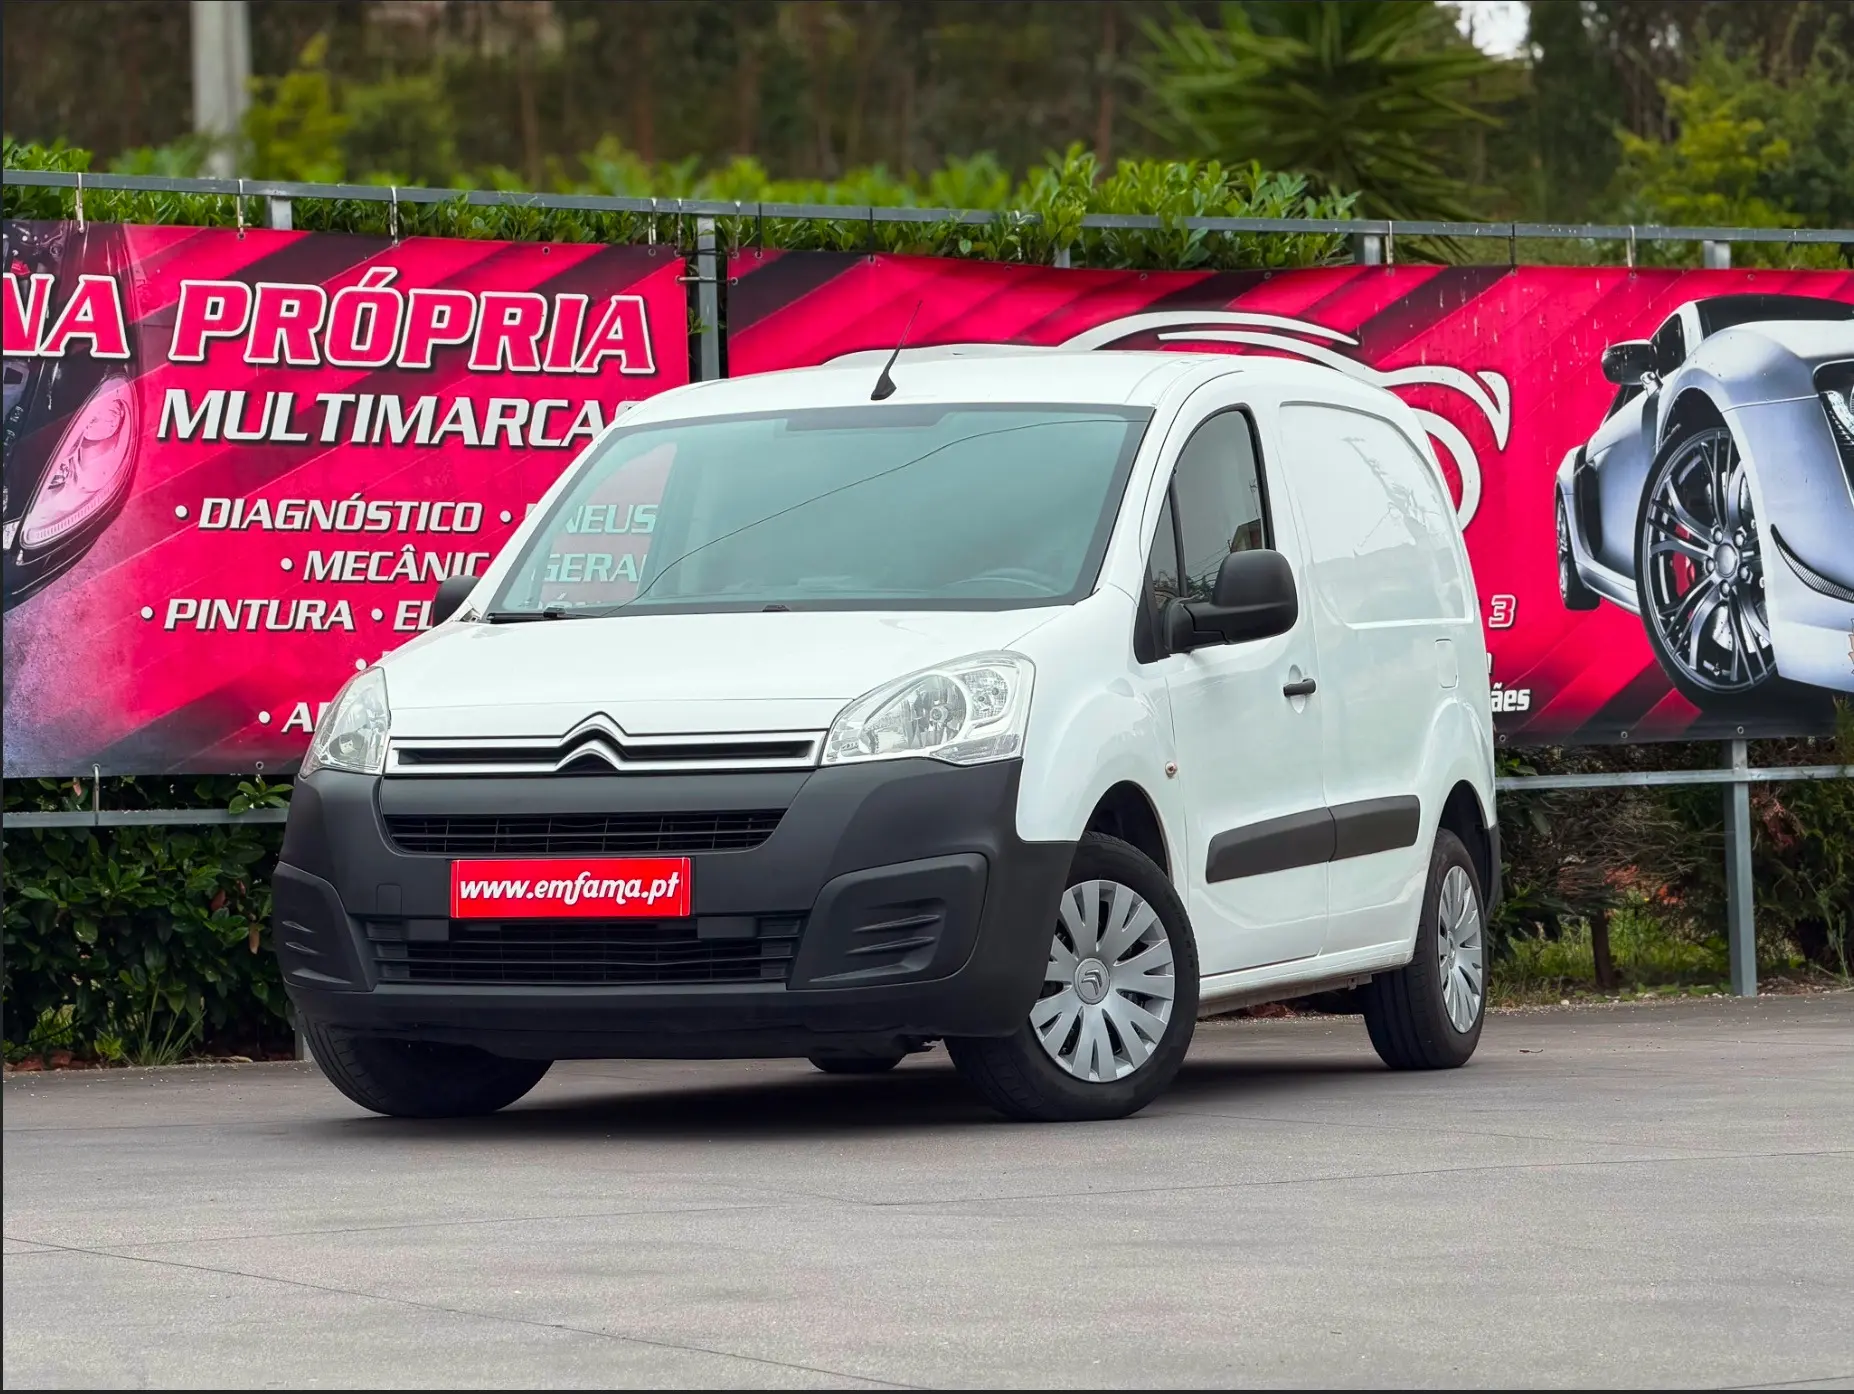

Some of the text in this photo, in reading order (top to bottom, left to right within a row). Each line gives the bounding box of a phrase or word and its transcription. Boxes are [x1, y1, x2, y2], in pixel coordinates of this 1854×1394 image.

[168, 267, 655, 374] PRÓPRIA
[199, 493, 483, 532] DIAGNÓSTICO
[164, 598, 354, 631] PINTURA
[460, 871, 680, 905] www.emfama.pt
